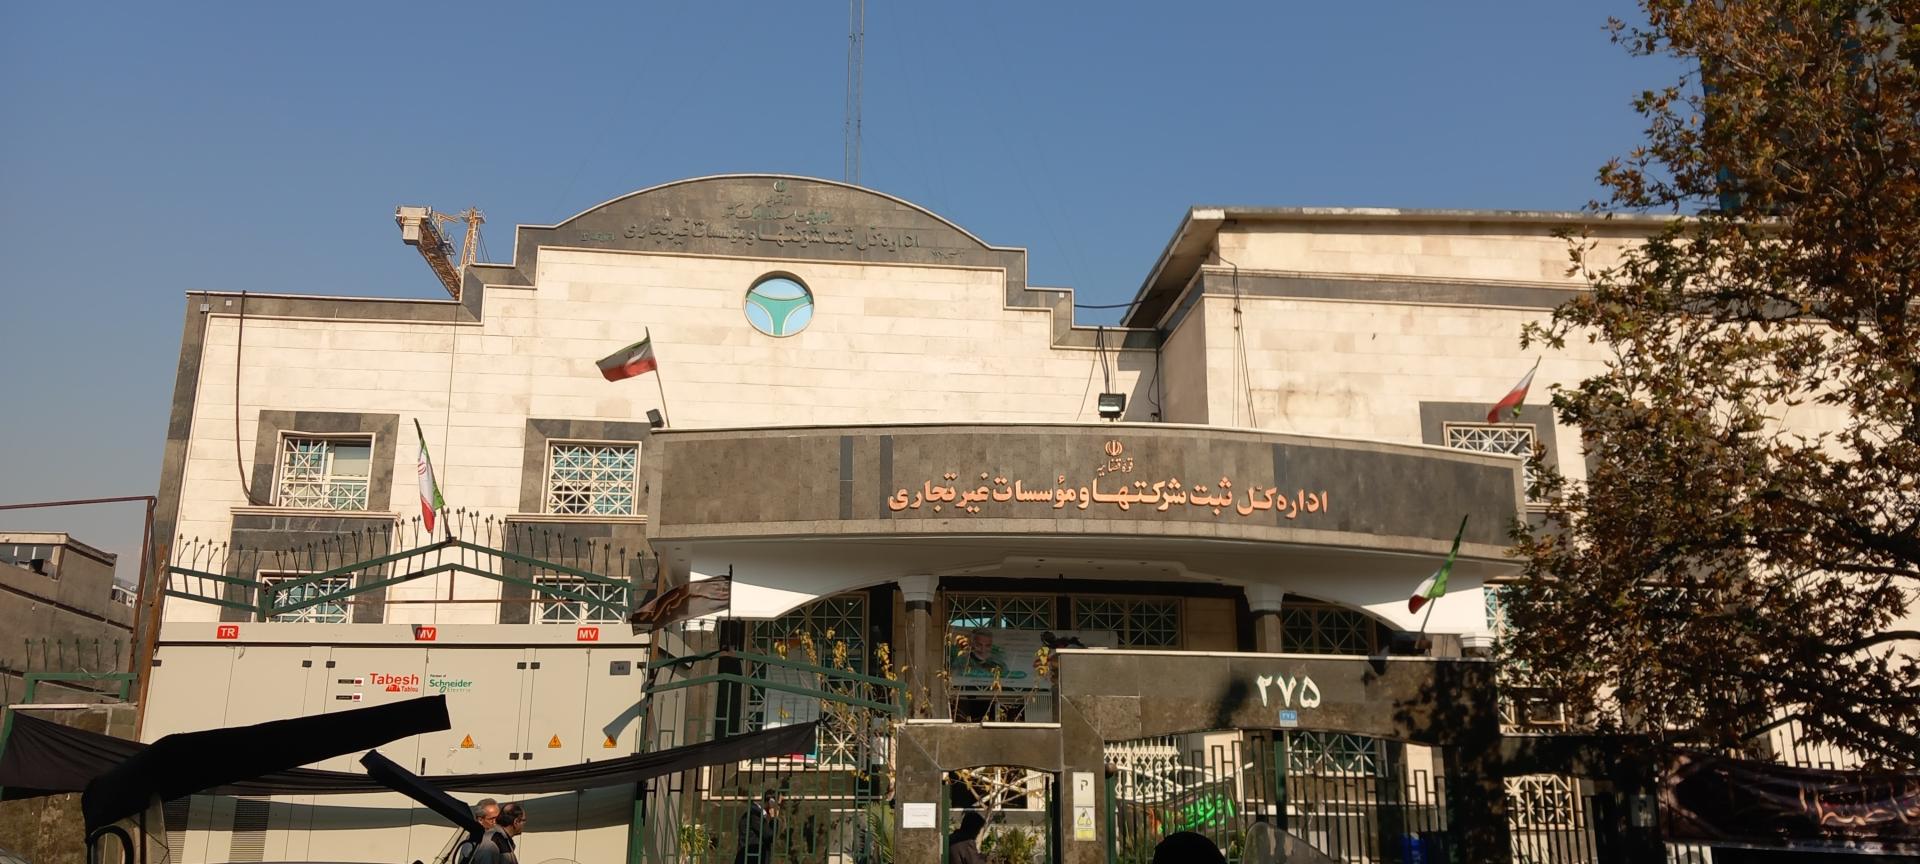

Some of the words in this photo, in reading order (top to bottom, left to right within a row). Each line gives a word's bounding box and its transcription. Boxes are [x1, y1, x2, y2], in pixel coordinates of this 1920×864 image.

[745, 231, 756, 246] و
[823, 227, 855, 252] ثبت
[888, 471, 958, 513] تجاری
[955, 471, 990, 514] غیر
[1077, 485, 1091, 510] و
[1092, 476, 1187, 512] شرکتها
[1189, 475, 1233, 517] ثبت
[1276, 488, 1328, 519] اداره
[220, 627, 236, 637] TR
[417, 629, 434, 639] MV
[579, 629, 597, 640] MV
[370, 673, 419, 686] Tabesh
[429, 679, 472, 688] Schneider
[1256, 674, 1321, 709] ۲۷۵
